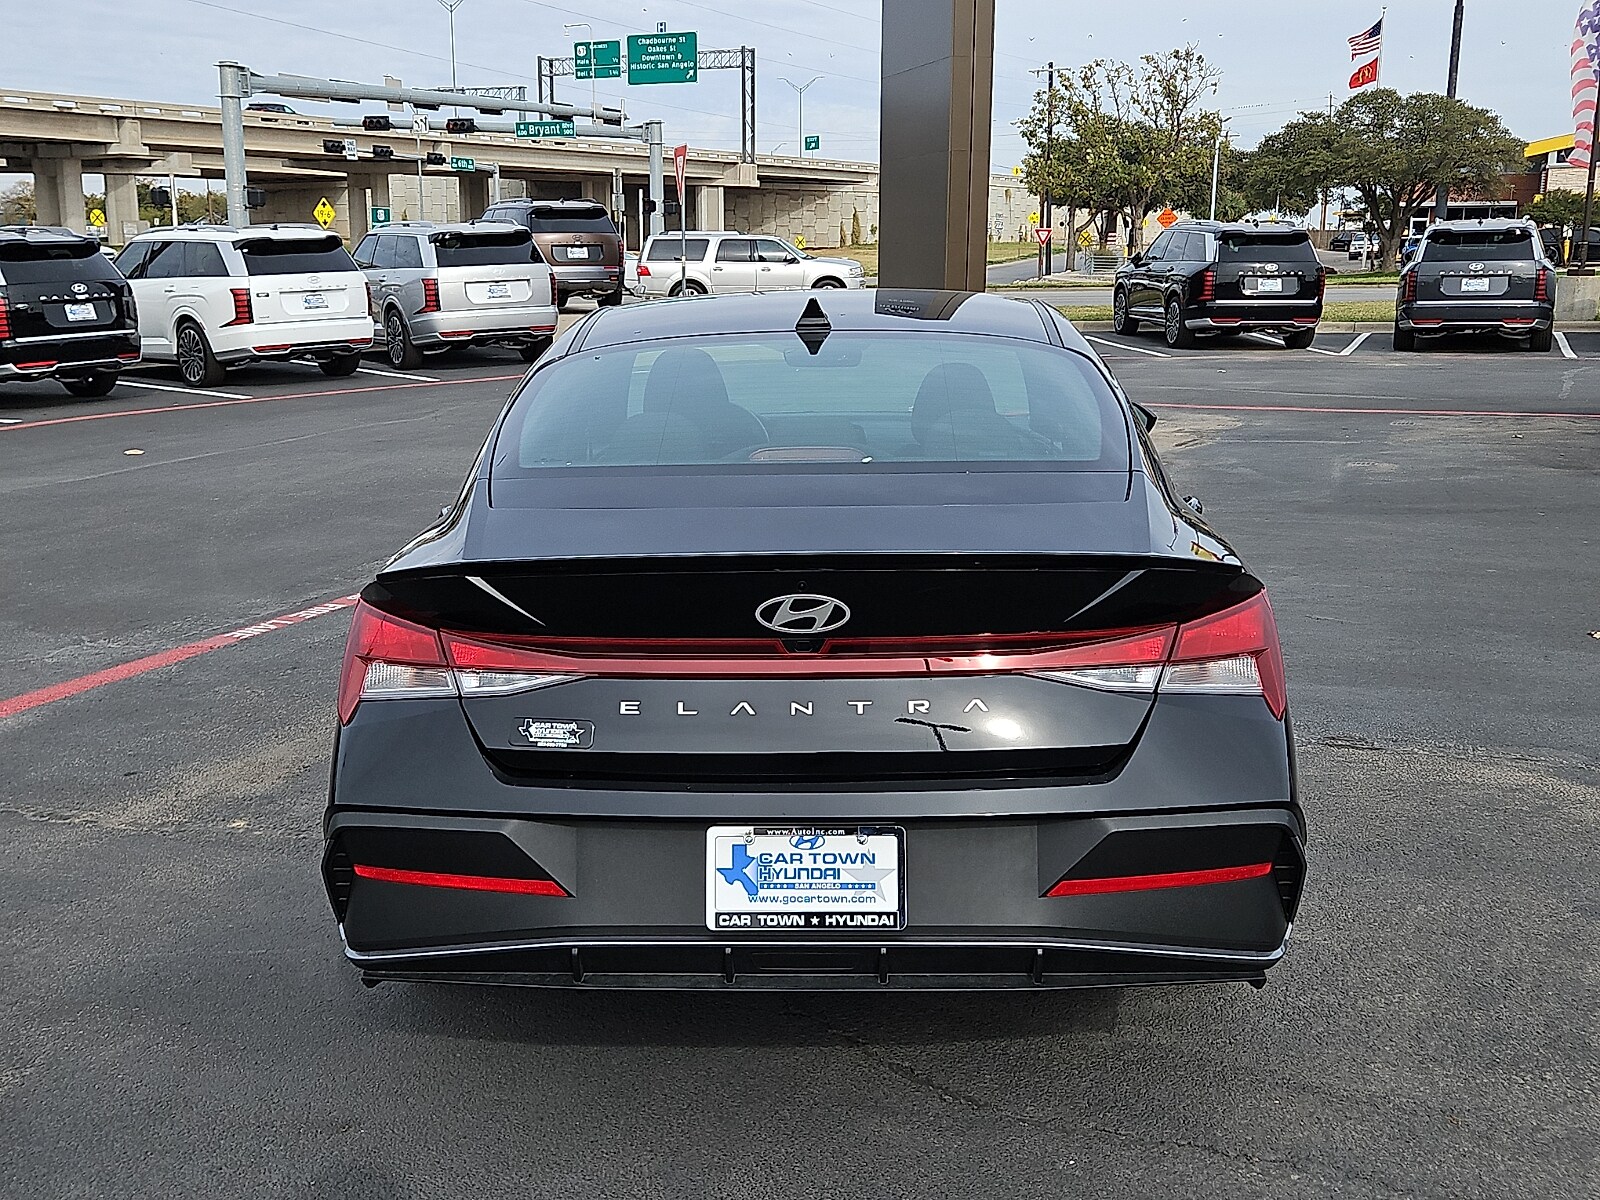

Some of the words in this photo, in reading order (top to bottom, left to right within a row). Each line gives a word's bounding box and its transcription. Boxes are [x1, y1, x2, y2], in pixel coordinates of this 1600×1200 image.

[638, 37, 677, 45] Chadbourne
[630, 62, 656, 71] Historic
[671, 61, 695, 70] Angelo
[529, 124, 560, 136] Bryant
[619, 698, 990, 716] ELANTRA
[766, 827, 845, 836] www.AutoInc.com
[758, 852, 804, 865] CAR
[809, 852, 876, 865] TOWN
[758, 867, 841, 880] HYUNDAI
[748, 895, 876, 905] www.gocartown.com
[718, 914, 752, 926] CAR
[757, 914, 805, 926] TOWN
[825, 914, 894, 926] HYUNDAI
